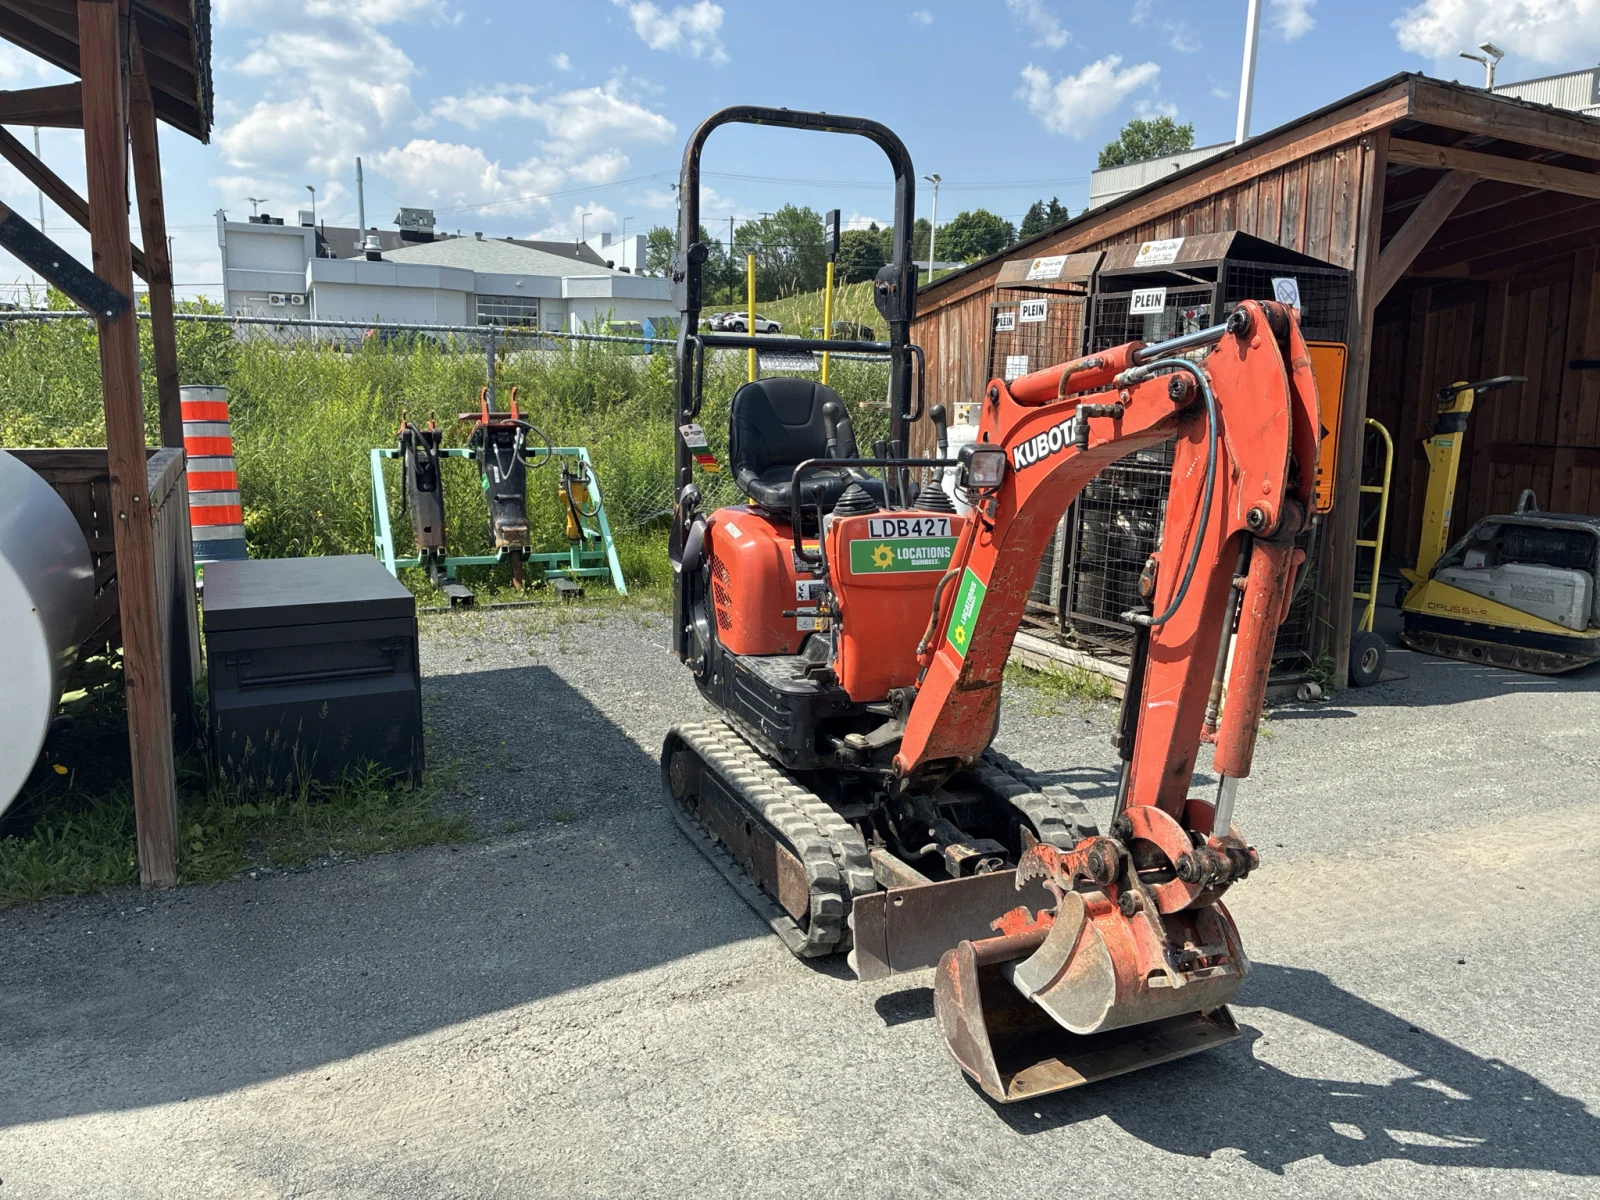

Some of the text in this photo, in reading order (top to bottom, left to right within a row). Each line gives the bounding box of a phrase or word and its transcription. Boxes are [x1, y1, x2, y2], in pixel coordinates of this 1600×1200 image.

[1134, 293, 1162, 308] PLEIN
[1022, 303, 1045, 317] PLEIN
[869, 518, 948, 538] LDB427
[896, 546, 951, 560] LOCATIONS
[960, 580, 977, 625] LOCATIONS
